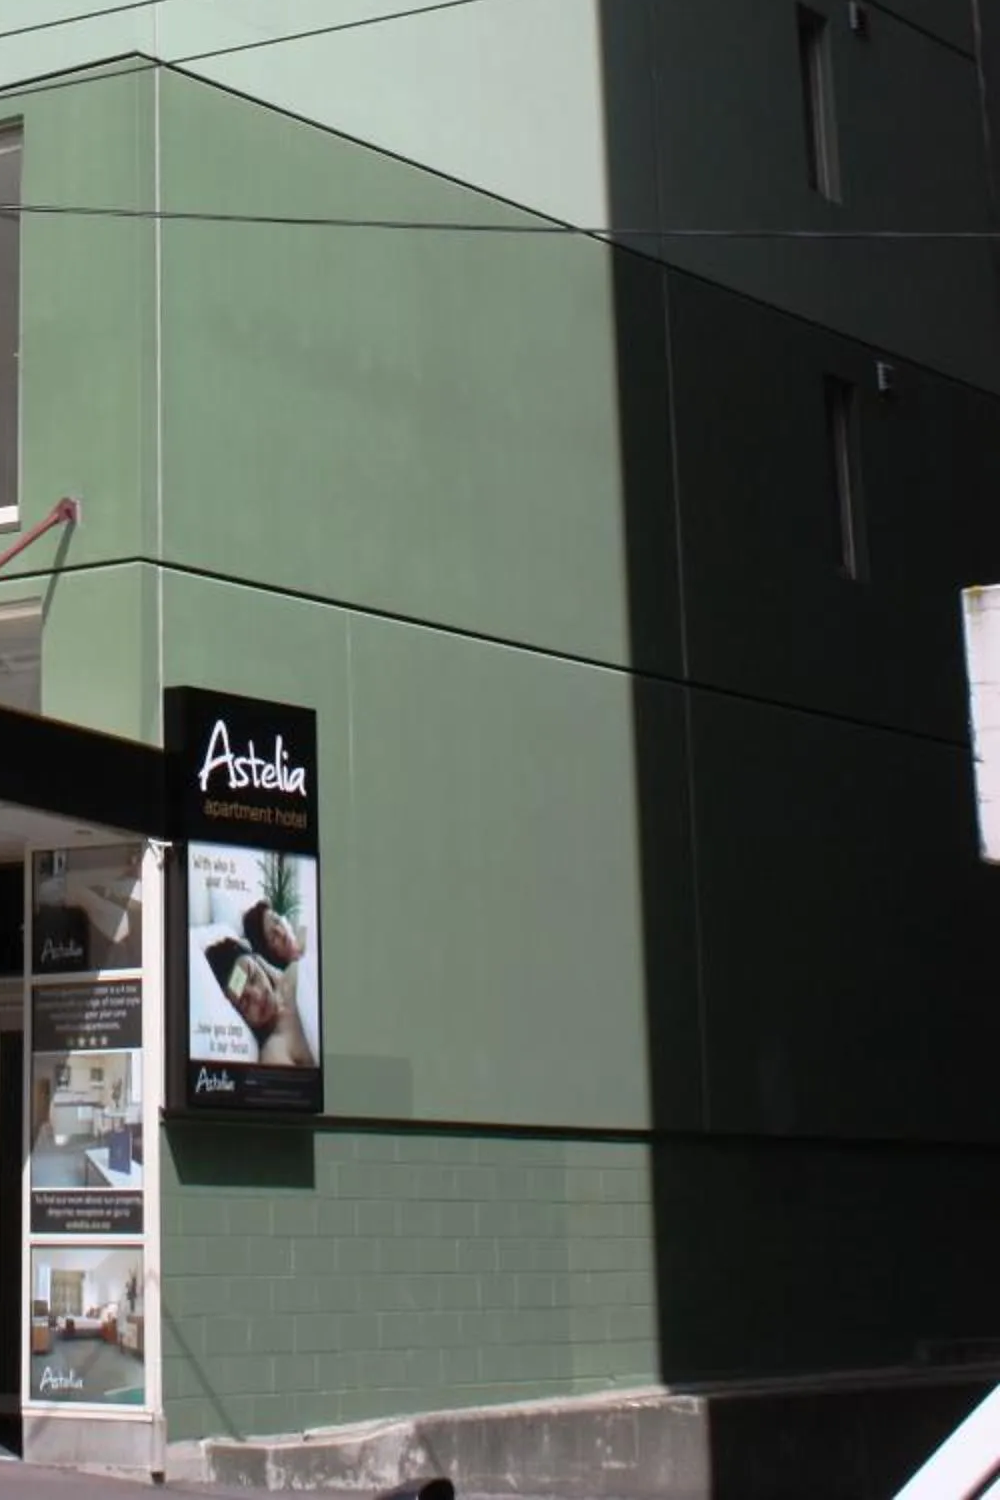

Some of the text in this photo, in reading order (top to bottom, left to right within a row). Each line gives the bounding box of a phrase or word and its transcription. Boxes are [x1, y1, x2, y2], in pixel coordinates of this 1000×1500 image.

[198, 719, 307, 797] Astelia
[204, 799, 307, 830] apartment hotel
[195, 1066, 236, 1093] Astelia
[40, 1366, 83, 1392] Astelia
